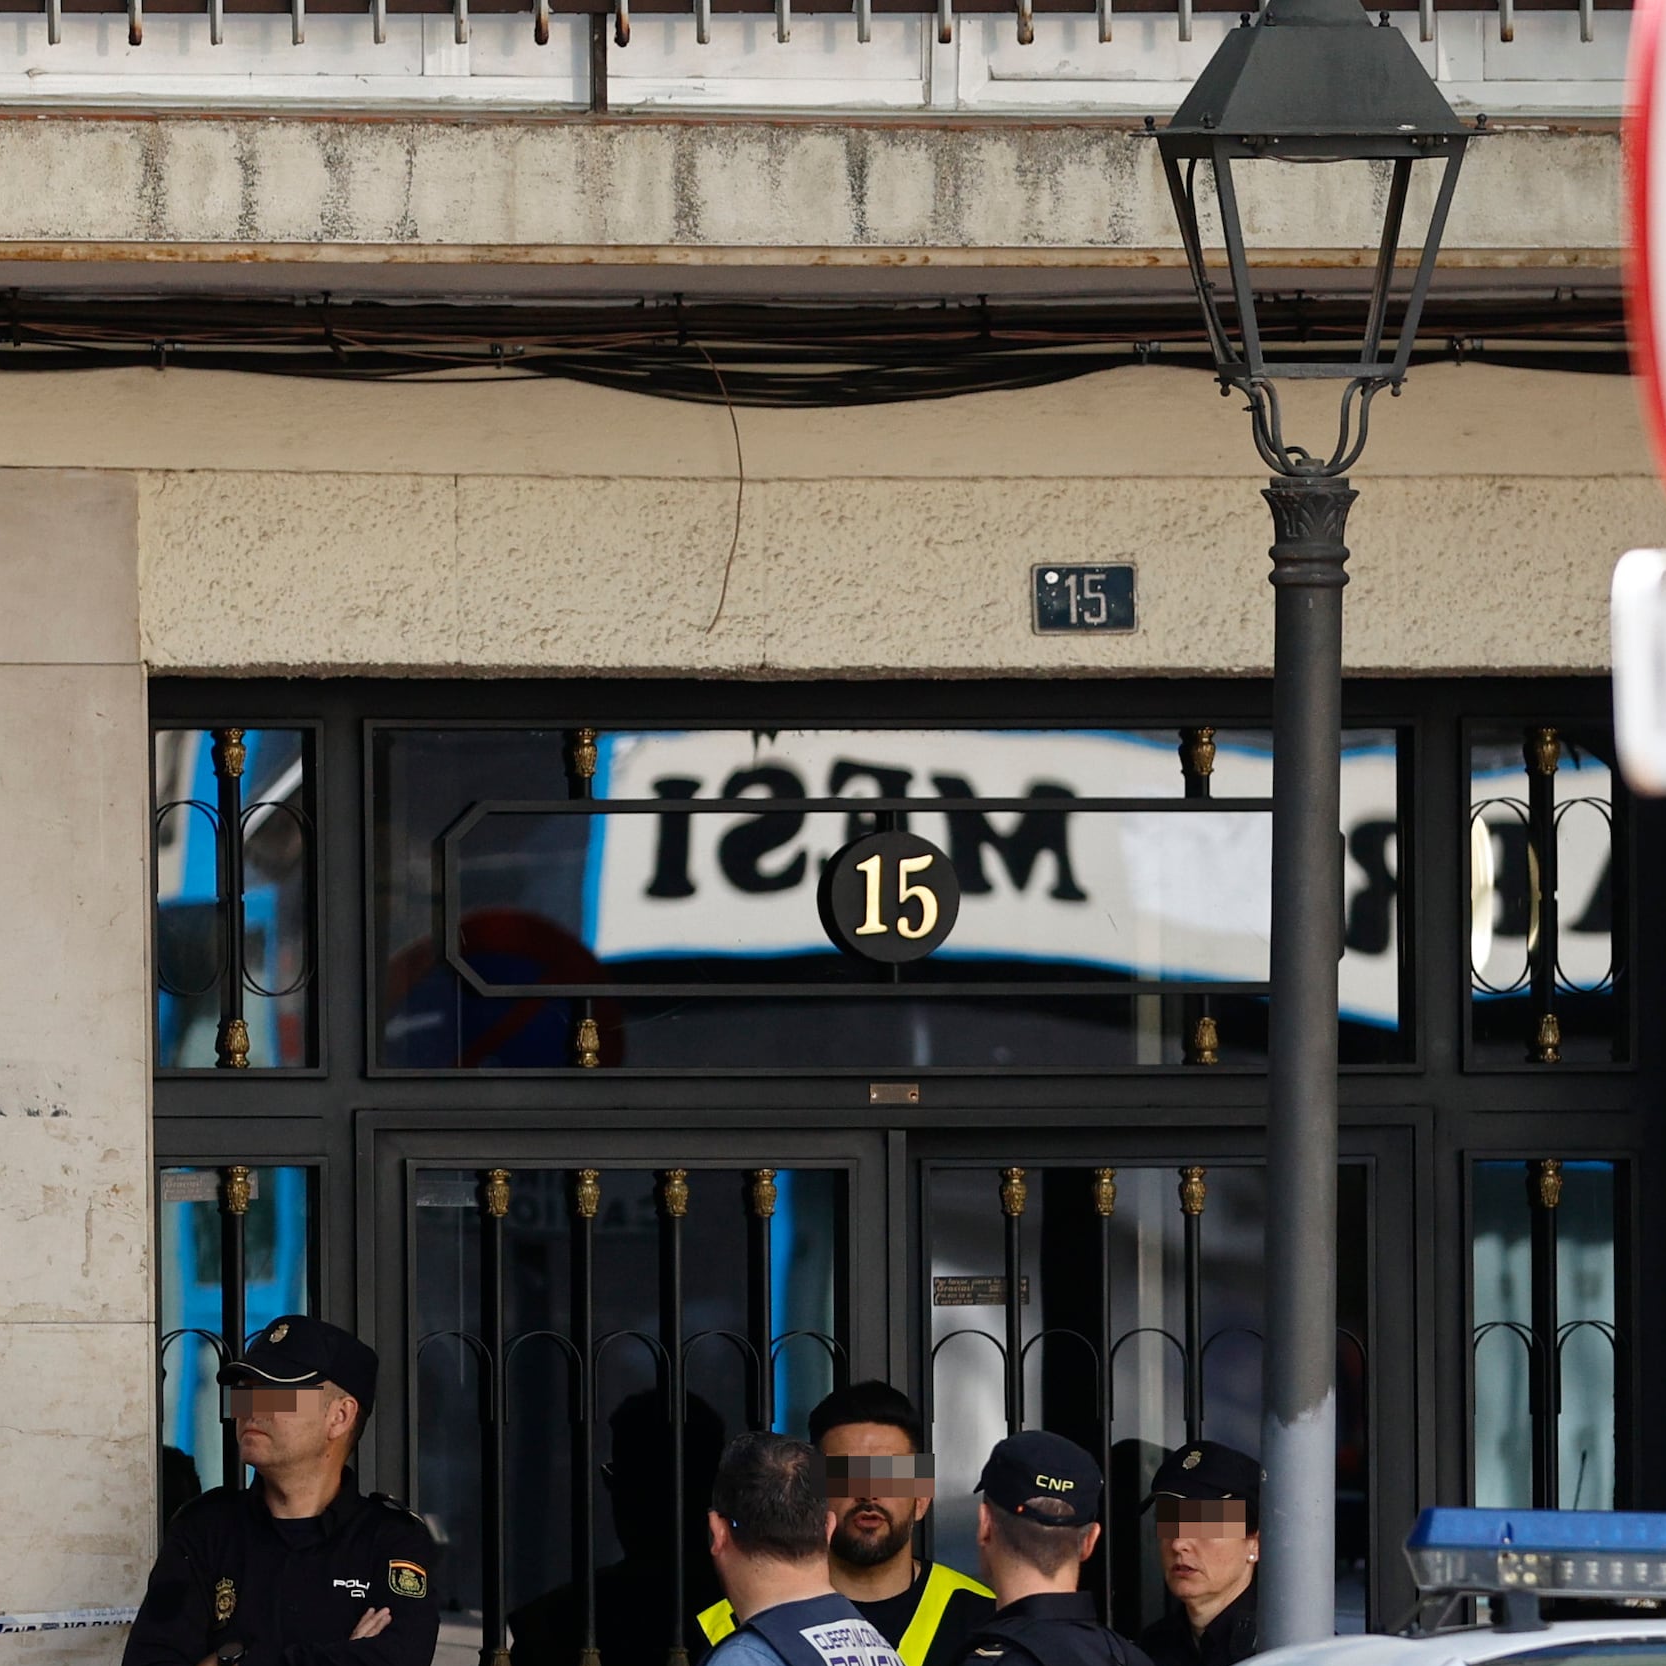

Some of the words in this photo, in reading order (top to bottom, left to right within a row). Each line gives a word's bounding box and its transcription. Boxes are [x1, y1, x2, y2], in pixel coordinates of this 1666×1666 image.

[1064, 573, 1108, 624] 15
[854, 853, 939, 940] 15
[1035, 1474, 1075, 1492] CNP
